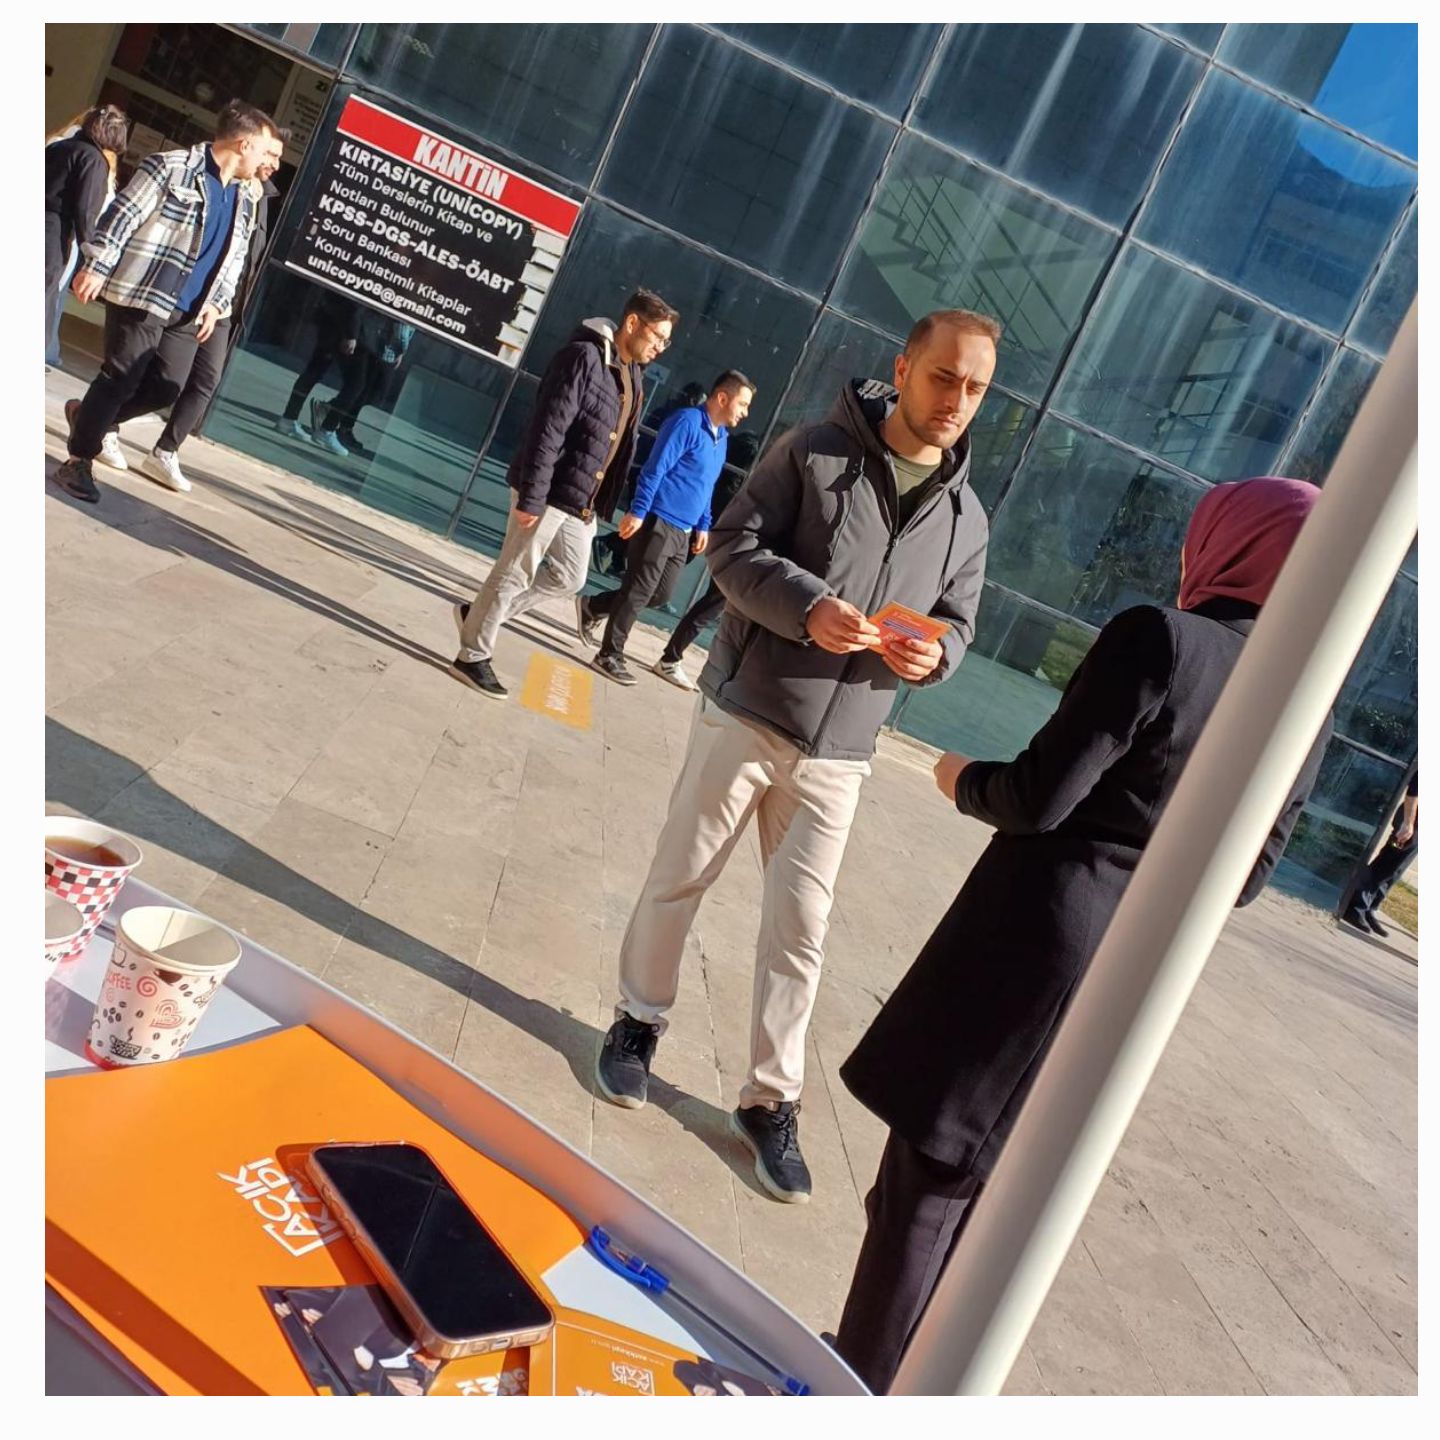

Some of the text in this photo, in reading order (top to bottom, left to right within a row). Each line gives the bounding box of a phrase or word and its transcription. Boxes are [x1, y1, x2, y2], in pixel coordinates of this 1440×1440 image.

[339, 141, 523, 240] KIRTASİYE (UNİCOPY)
[413, 134, 509, 201] KANTİN
[319, 194, 514, 295] KPSS-DGS-ALES-ÖABT
[322, 218, 355, 243] Soru
[357, 234, 411, 268] Bankası
[330, 180, 435, 237] Notları Bulunur
[372, 177, 434, 215] Derslerin
[437, 208, 474, 236] Kitap
[476, 230, 494, 244] ve
[307, 255, 467, 335] unicopy08@gmail.com
[314, 236, 351, 262] Konu
[352, 254, 415, 291] Anlatımlı
[416, 283, 472, 317] Kitaplar
